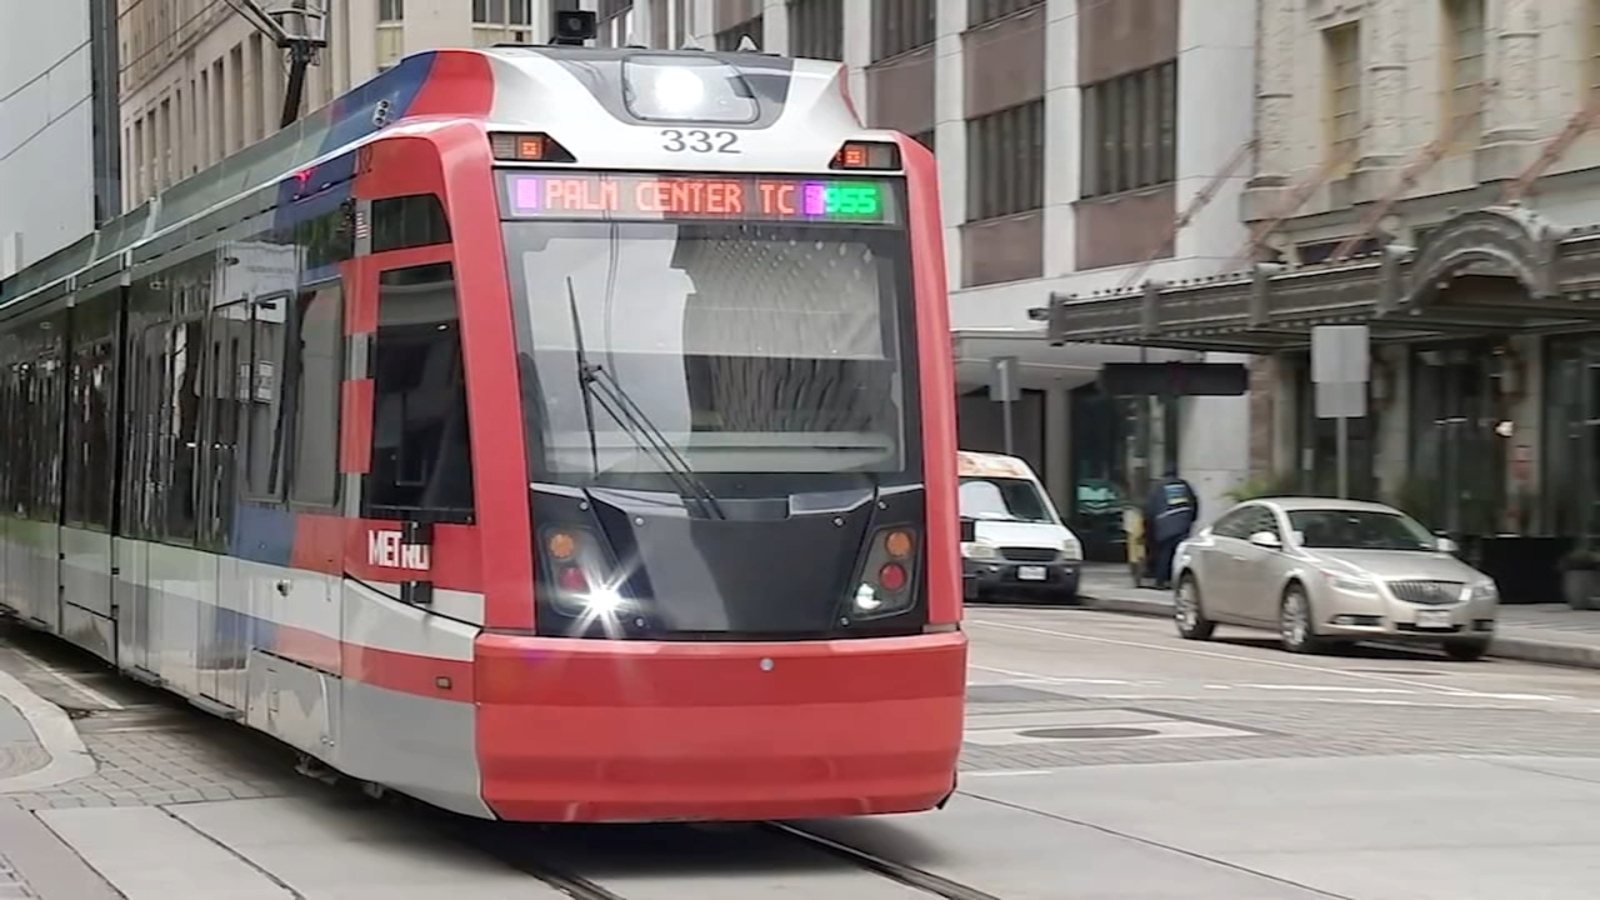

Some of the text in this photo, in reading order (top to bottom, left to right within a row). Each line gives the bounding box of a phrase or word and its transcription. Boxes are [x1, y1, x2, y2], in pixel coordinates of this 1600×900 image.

[660, 129, 742, 154] 332
[545, 179, 876, 214] PALM CENTER TC 955
